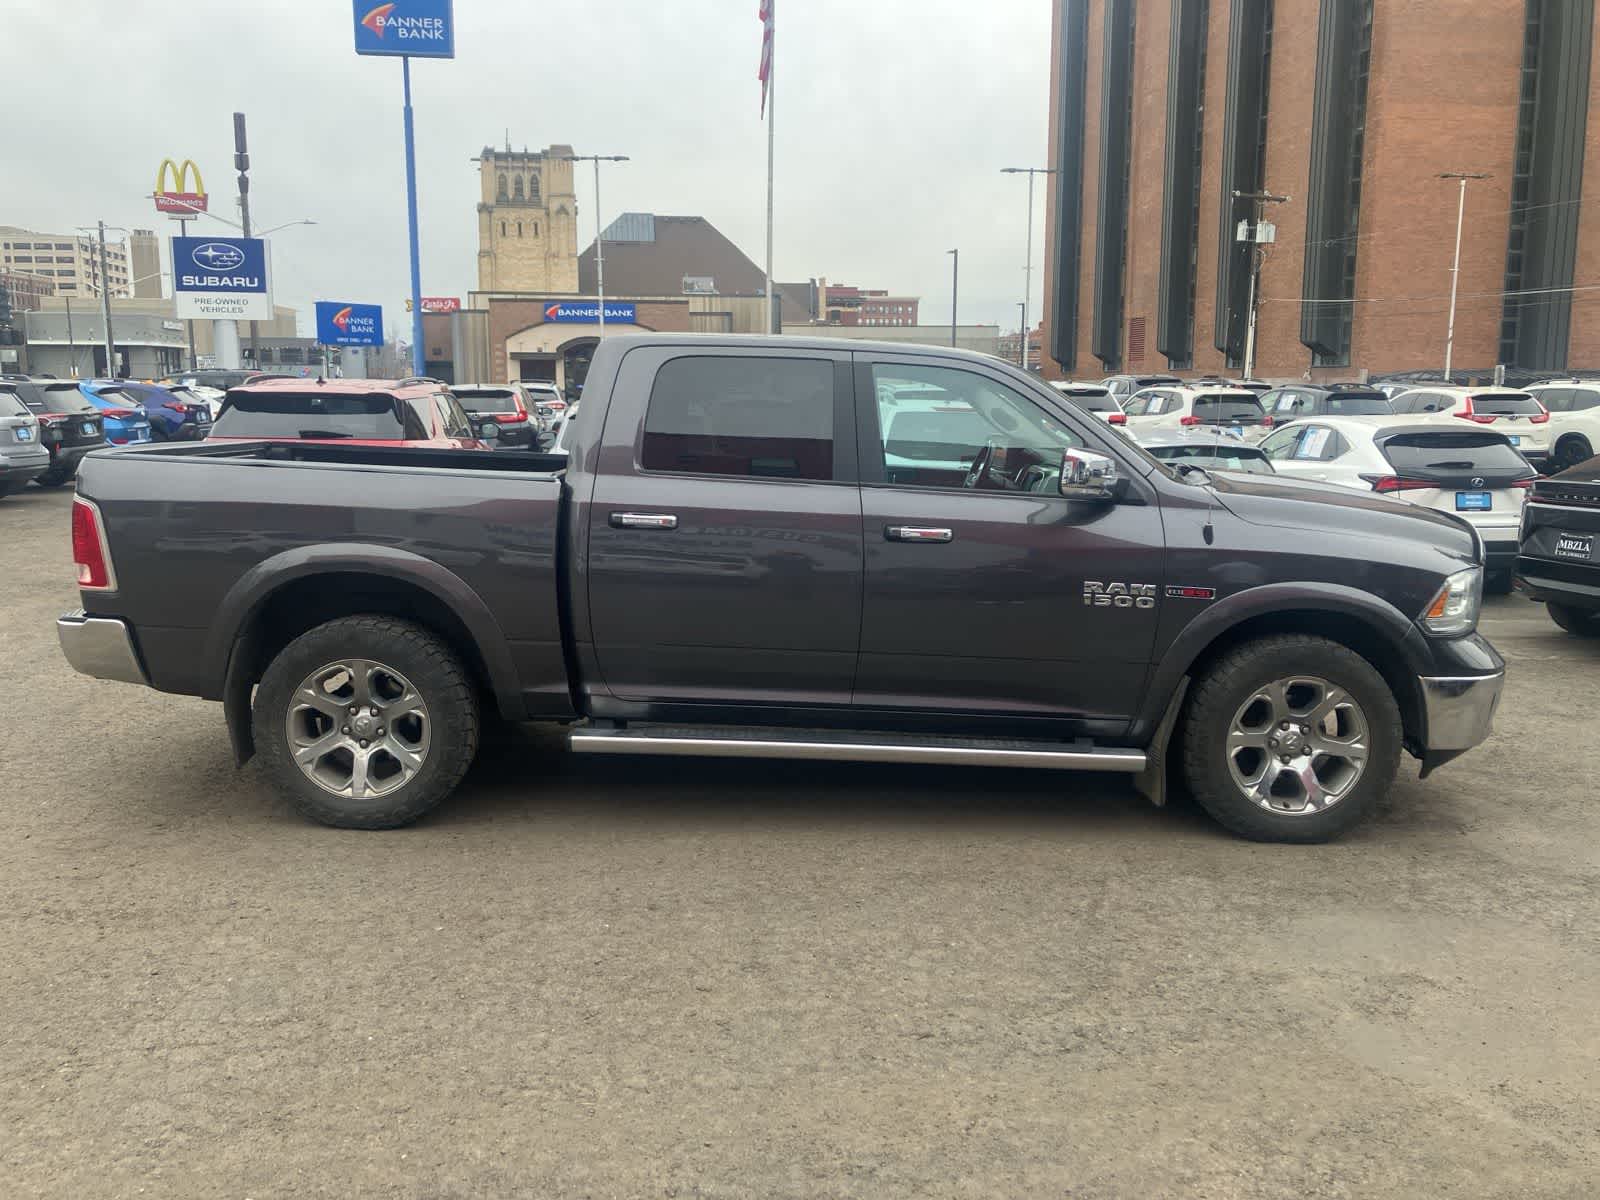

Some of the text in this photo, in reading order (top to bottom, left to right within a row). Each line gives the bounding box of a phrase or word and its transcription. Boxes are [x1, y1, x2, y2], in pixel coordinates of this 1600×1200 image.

[375, 16, 444, 29] BANNER
[398, 28, 445, 40] BANK
[182, 275, 259, 288] SUBARU
[194, 297, 249, 306] PRE-OWNED
[200, 306, 245, 314] VEHICLES
[557, 308, 633, 317] BANNER BANK
[339, 317, 375, 326] BANNER
[351, 325, 375, 334] BANK
[1559, 539, 1590, 552] MBZLA
[1083, 580, 1157, 597] RAM
[1083, 594, 1155, 609] 1500
